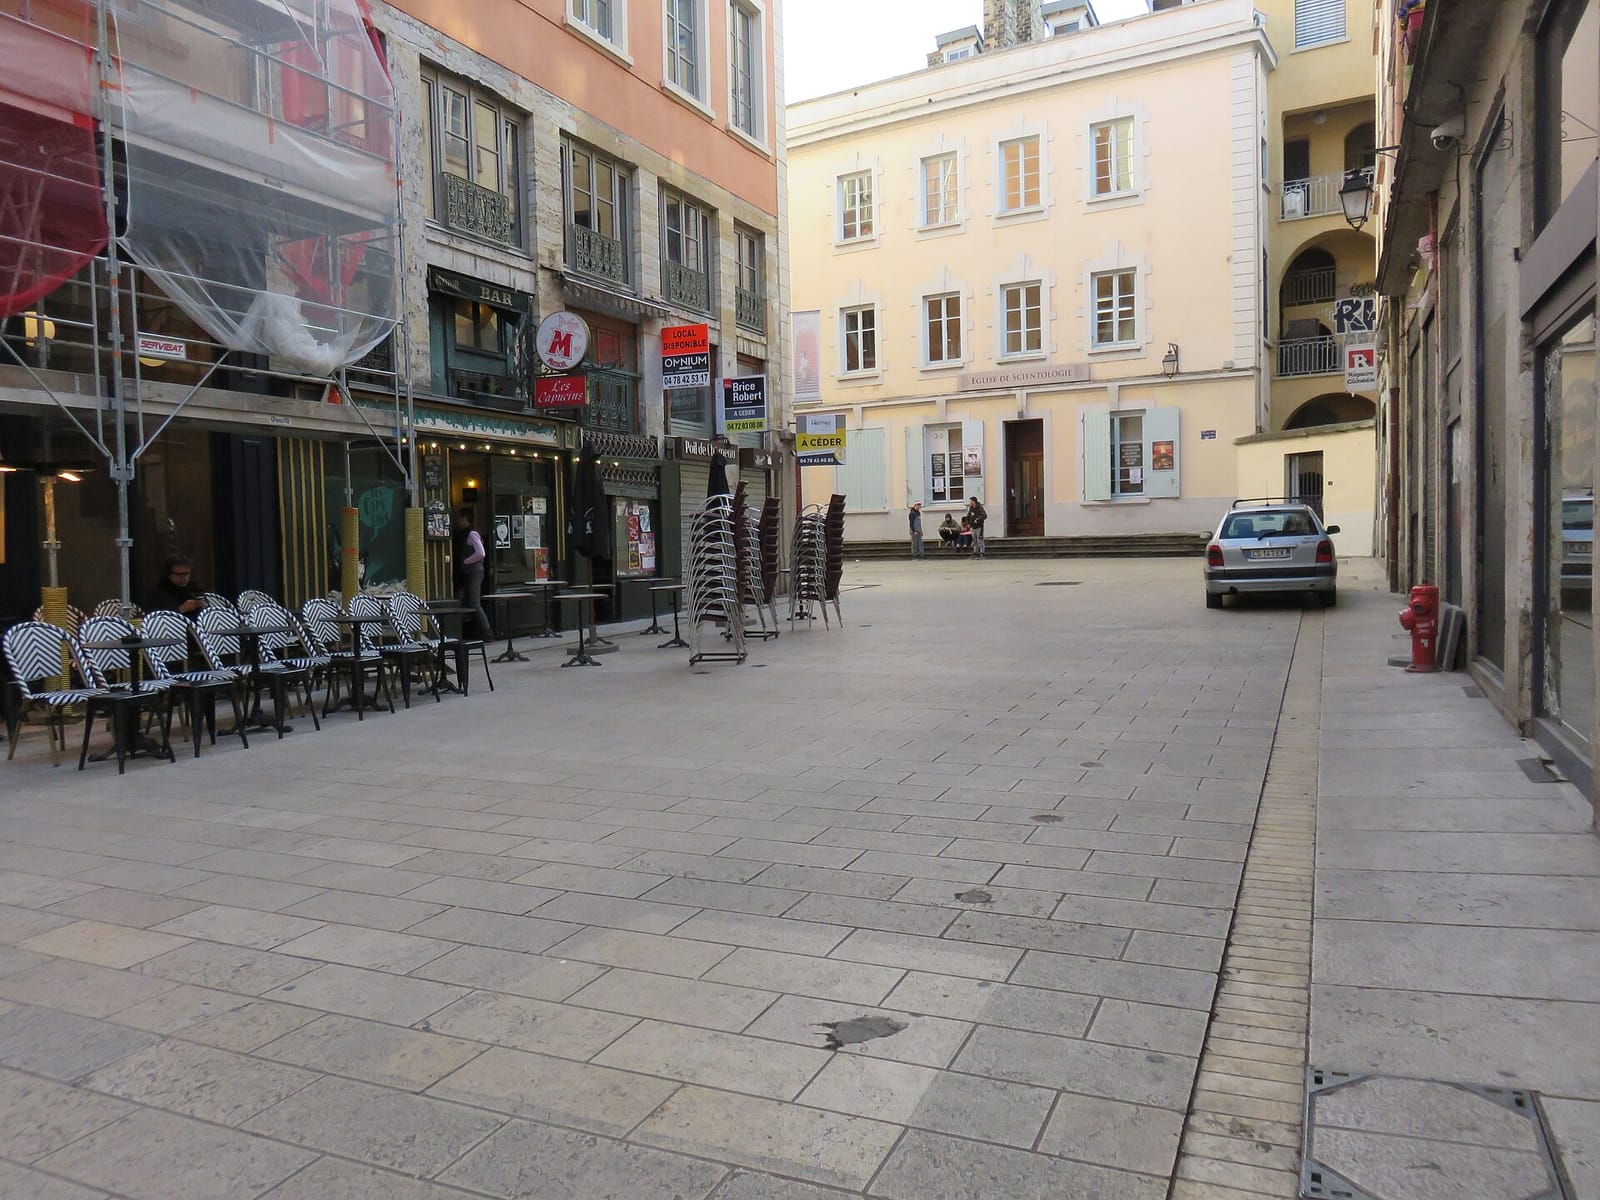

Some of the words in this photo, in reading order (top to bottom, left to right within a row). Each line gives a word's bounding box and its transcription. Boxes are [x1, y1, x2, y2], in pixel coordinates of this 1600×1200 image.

[480, 286, 512, 306] BAR
[672, 329, 697, 339] LOCAL
[663, 339, 708, 351] DISPONIBLE
[664, 355, 707, 368] OMNIUM
[664, 376, 672, 386] 04
[674, 375, 681, 384] 78
[682, 374, 690, 384] 42
[691, 373, 699, 383] 53
[701, 372, 708, 382] 17
[1012, 368, 1073, 381] SCIENTOLOGIE
[551, 380, 571, 393] Les
[732, 382, 756, 392] Brice
[538, 391, 584, 404] Capucins
[732, 391, 762, 402] Robert
[685, 440, 698, 455] Poil
[699, 441, 707, 456] de
